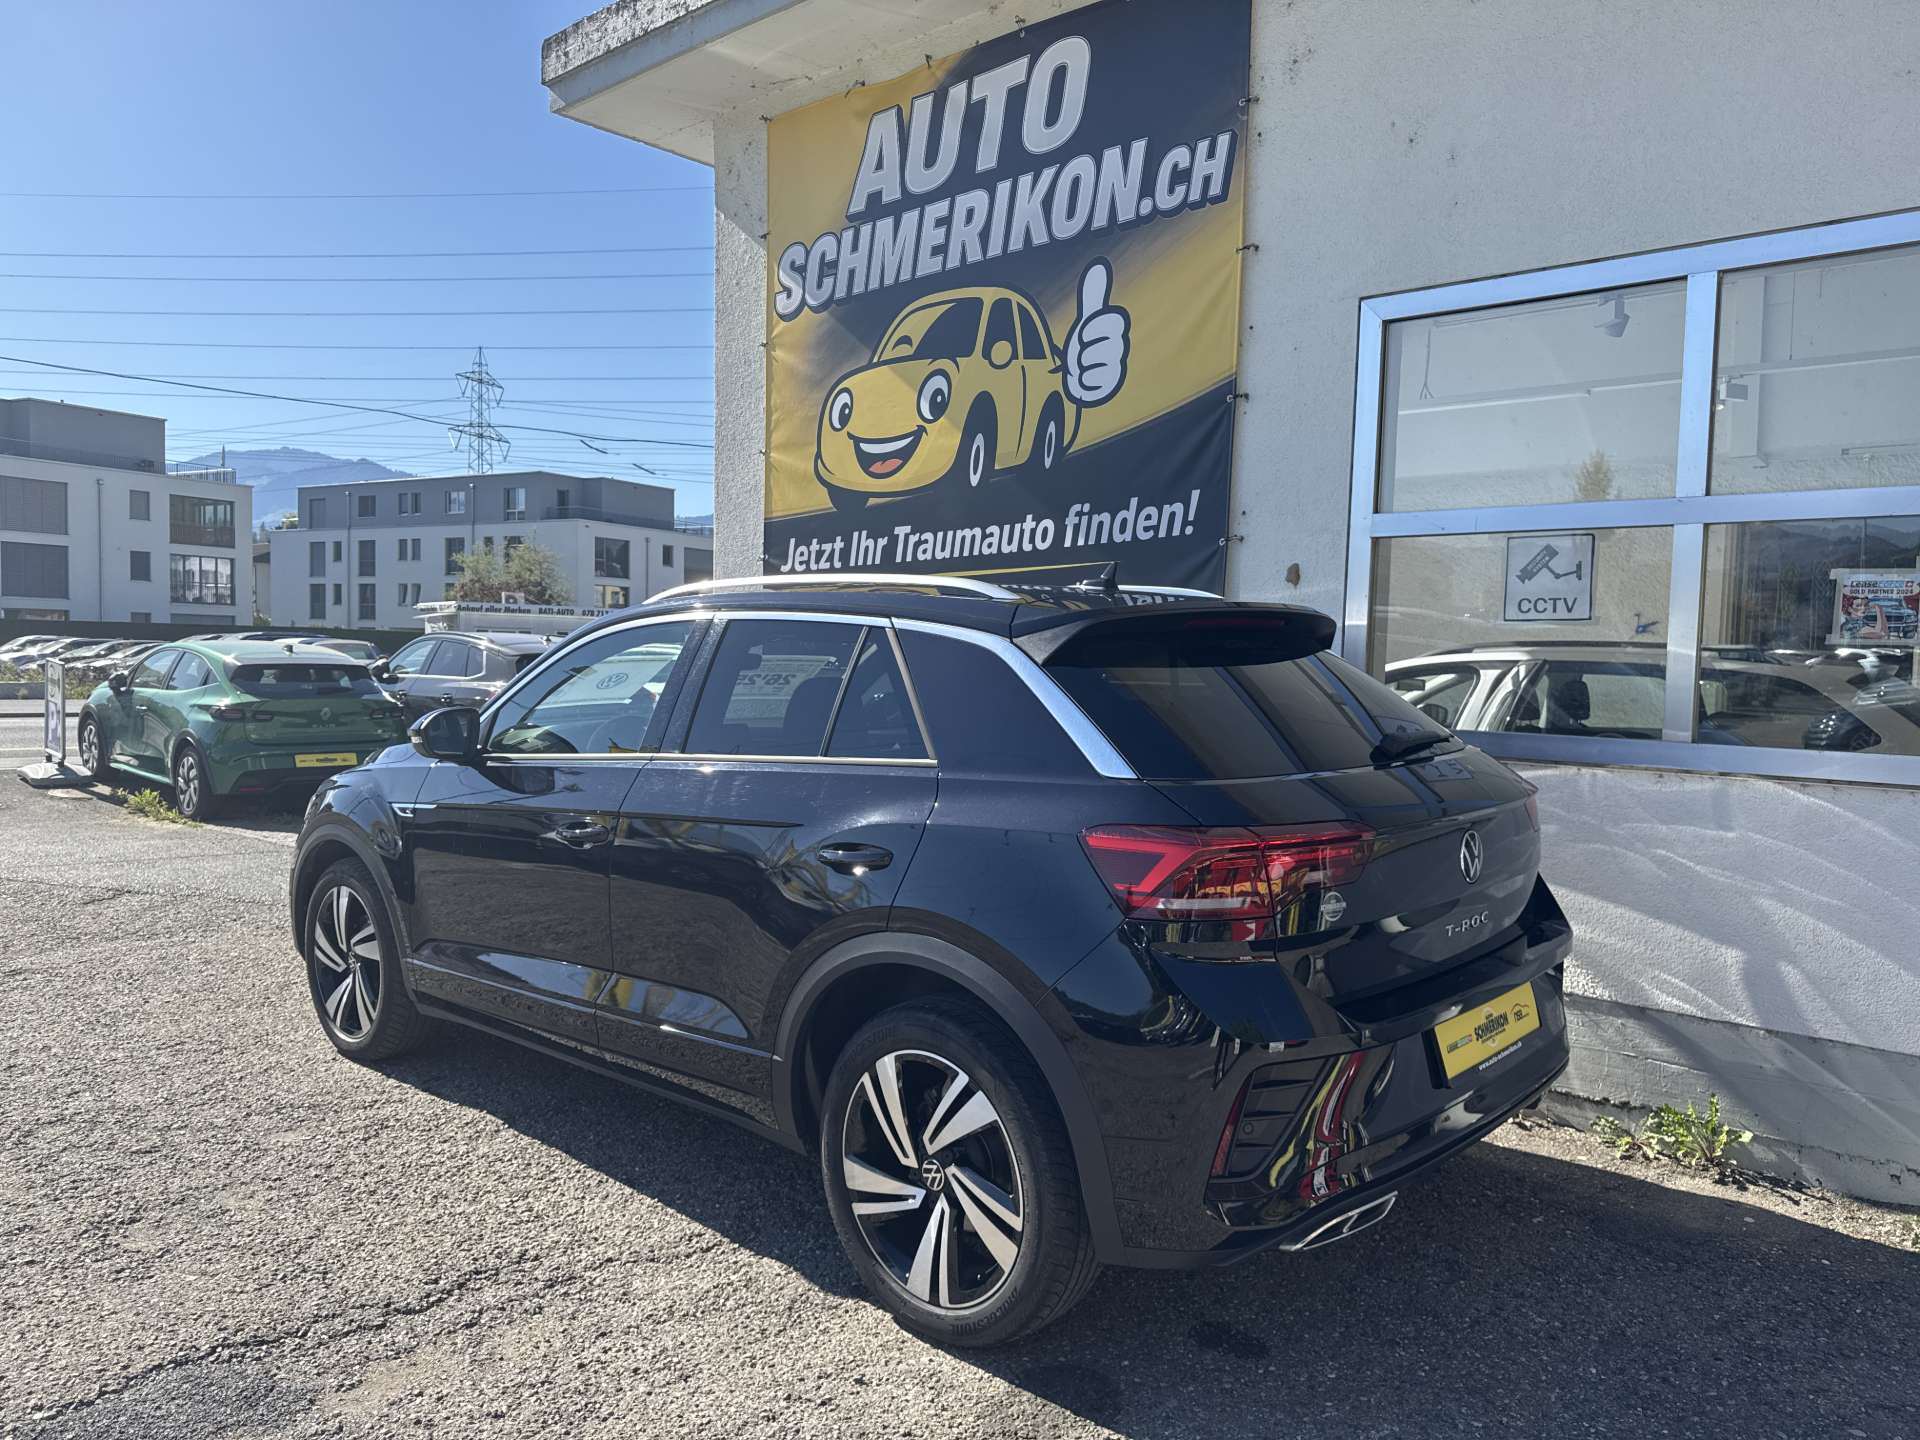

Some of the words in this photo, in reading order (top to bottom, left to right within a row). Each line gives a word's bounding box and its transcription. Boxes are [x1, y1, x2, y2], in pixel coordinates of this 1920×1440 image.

[847, 35, 1091, 216] AUTO
[775, 131, 1233, 317] SCHMERIKON.CH
[780, 536, 844, 573] Jetzt
[850, 530, 885, 567] Ihr
[894, 513, 1054, 565] Traumauto
[1065, 489, 1201, 548] finden!
[456, 603, 484, 612] Ankauf
[503, 605, 531, 614] Marken
[1517, 597, 1577, 614] CCTV
[1445, 911, 1489, 937] T-ROC
